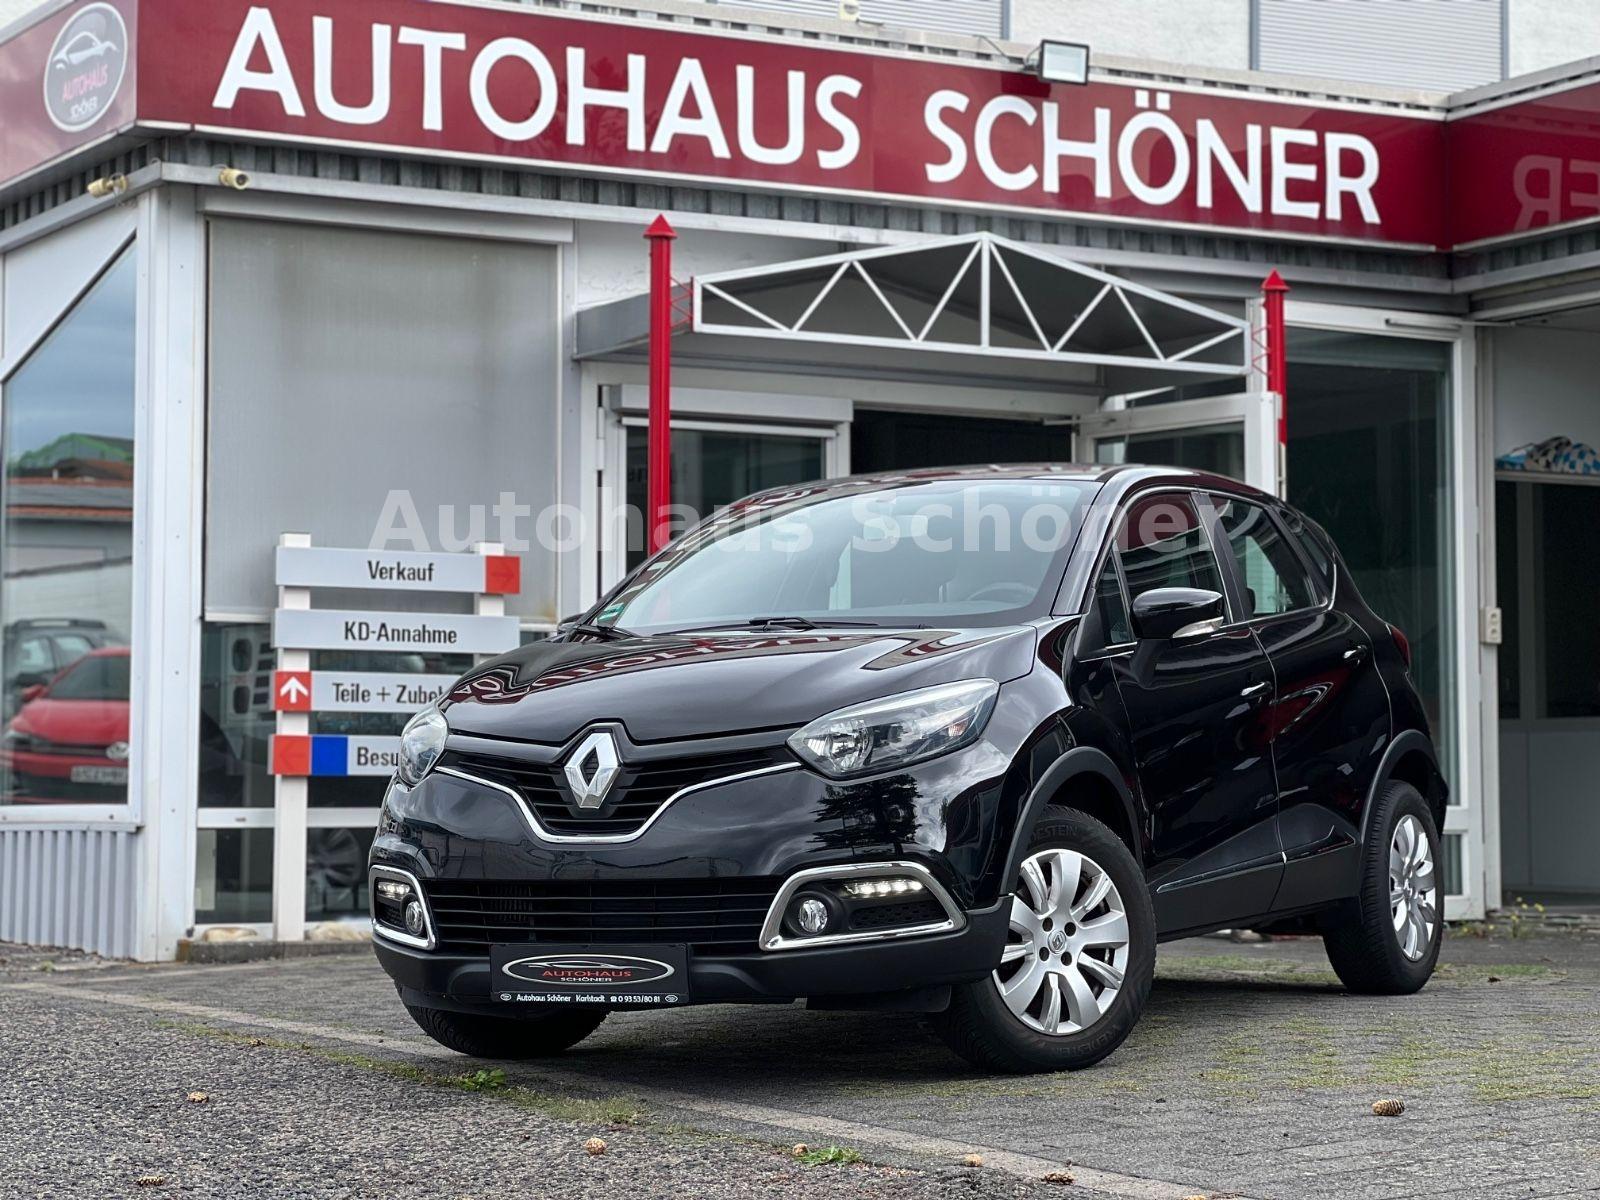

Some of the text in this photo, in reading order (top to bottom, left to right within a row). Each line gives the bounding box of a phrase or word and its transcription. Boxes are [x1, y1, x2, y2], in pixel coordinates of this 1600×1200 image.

[212, 6, 1380, 225] AUTOHAUS SCHÖNER
[367, 560, 434, 582] Verkauf
[344, 621, 457, 644] KD-Annahme
[332, 683, 371, 703] Teile
[376, 686, 391, 702] +
[547, 994, 571, 1002] Schöner
[576, 994, 605, 1002] Karlstadt
